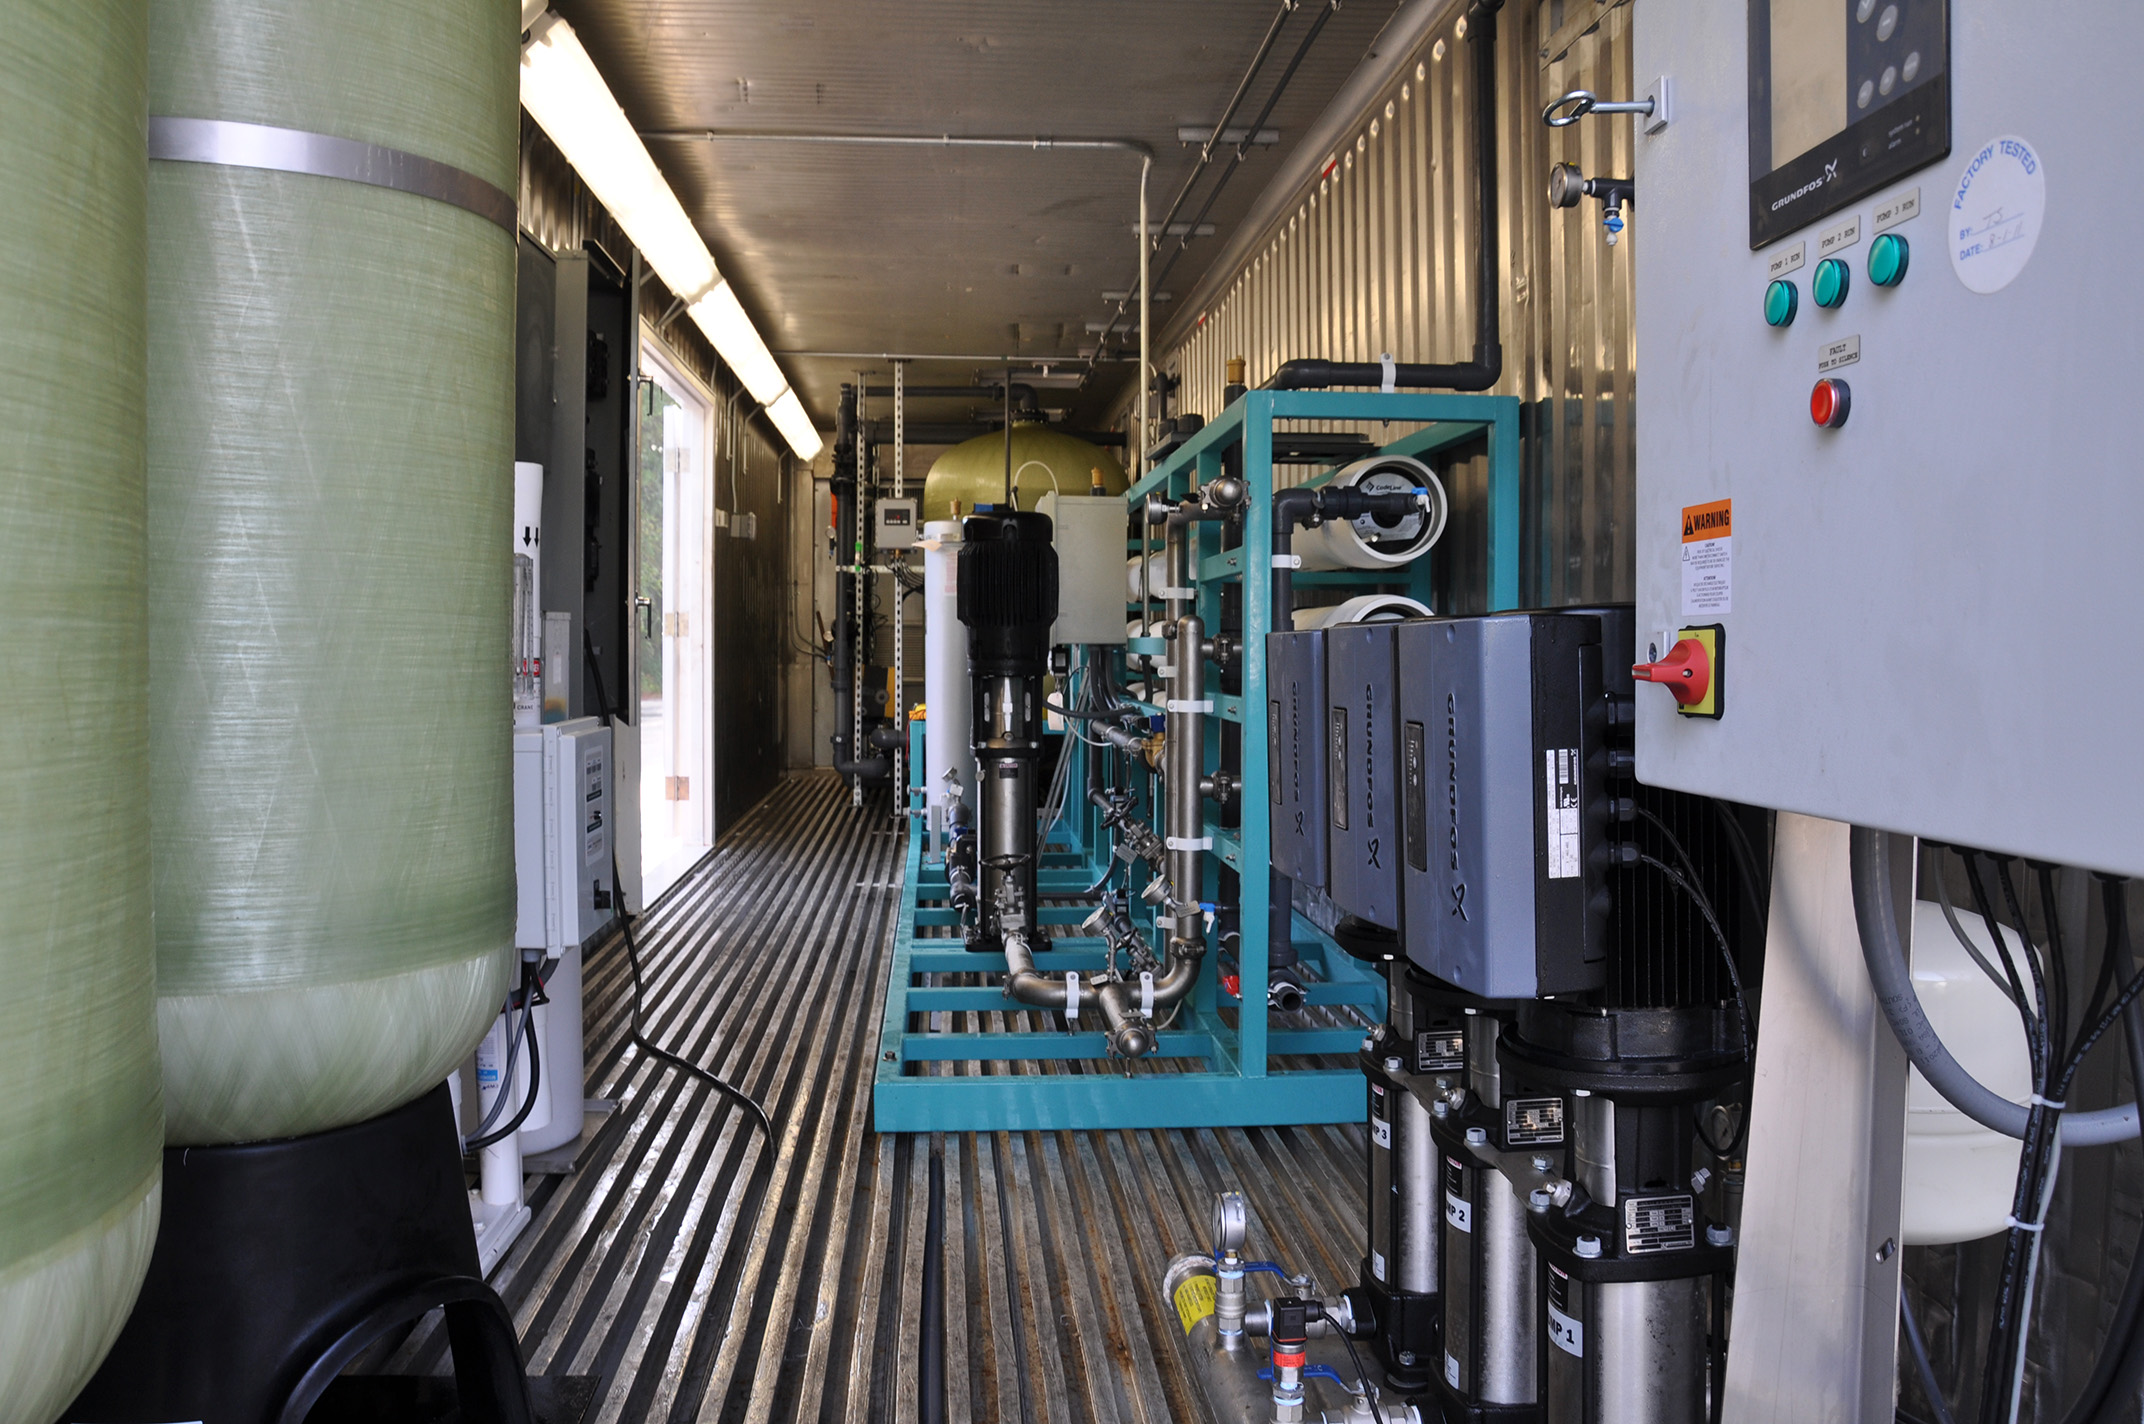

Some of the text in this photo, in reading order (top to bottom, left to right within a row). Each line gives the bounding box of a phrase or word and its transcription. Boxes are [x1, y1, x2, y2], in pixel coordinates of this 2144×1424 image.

[1954, 140, 2036, 210] FACTORY TESTED
[1771, 177, 1824, 211] GRUNDFOS
[1876, 210, 1892, 223] PUMP
[1902, 199, 1915, 212] RUN
[1821, 236, 1835, 248] PUMP
[1844, 226, 1856, 238] RUN
[1770, 260, 1782, 272] PUMP
[1790, 252, 1800, 263] RUN
[1693, 509, 1730, 531] WARNING
[1365, 684, 1374, 828] GRUNDFOS
[1447, 693, 1459, 871] GRUNDFOS
[1381, 1129, 1388, 1140] 3
[1458, 1209, 1466, 1223] 2
[1566, 1329, 1575, 1345] 1
